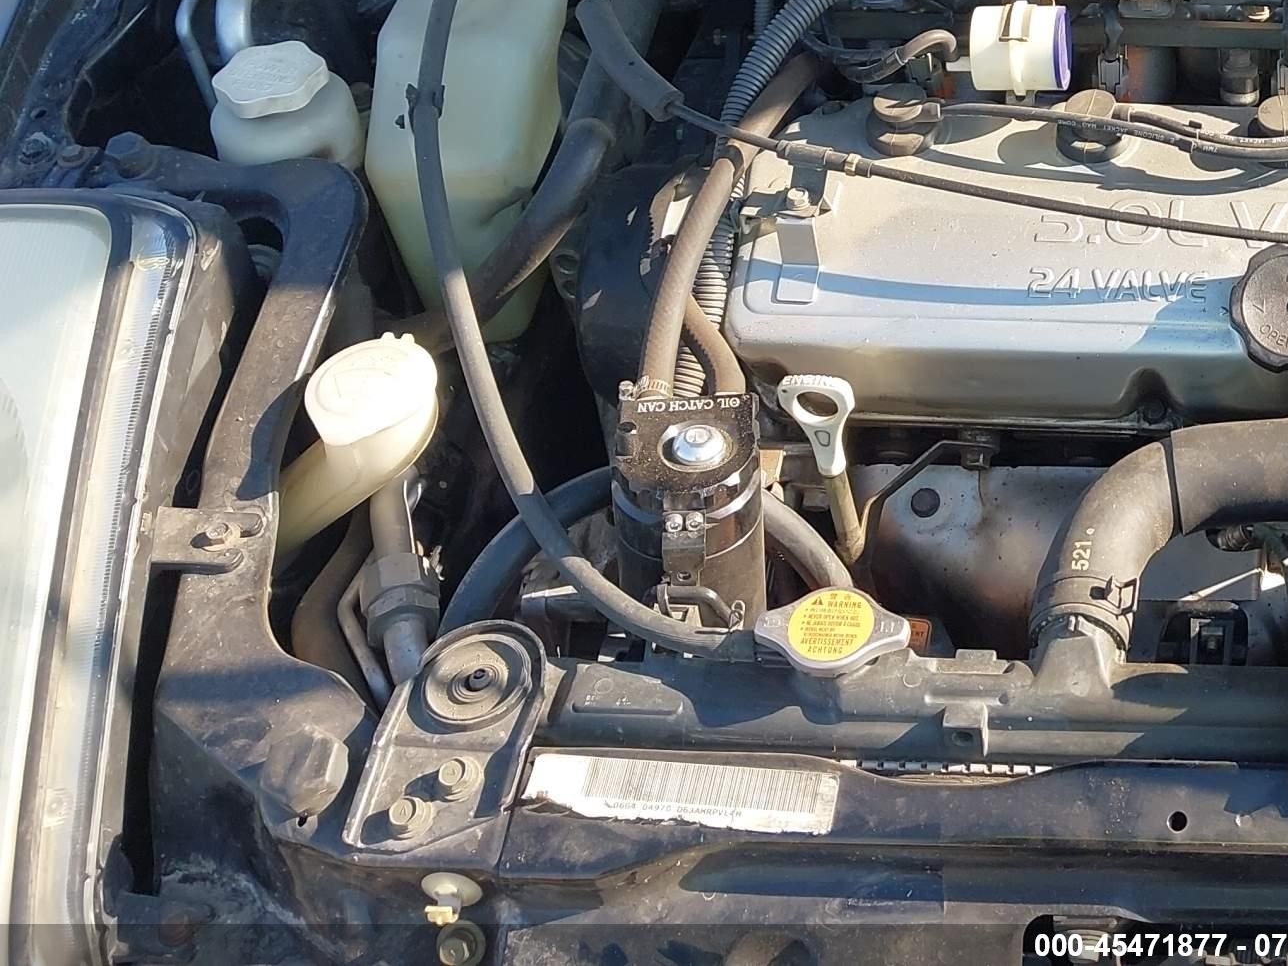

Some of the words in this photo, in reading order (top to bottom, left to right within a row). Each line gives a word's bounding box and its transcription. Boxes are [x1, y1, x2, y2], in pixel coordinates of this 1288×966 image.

[1027, 266, 1082, 299] 24
[1091, 267, 1208, 303] VALVE
[637, 401, 666, 413] CAN
[669, 399, 714, 412] CATCH
[717, 397, 741, 409] OIL
[1071, 540, 1093, 571] 521
[827, 600, 862, 609] WARNING
